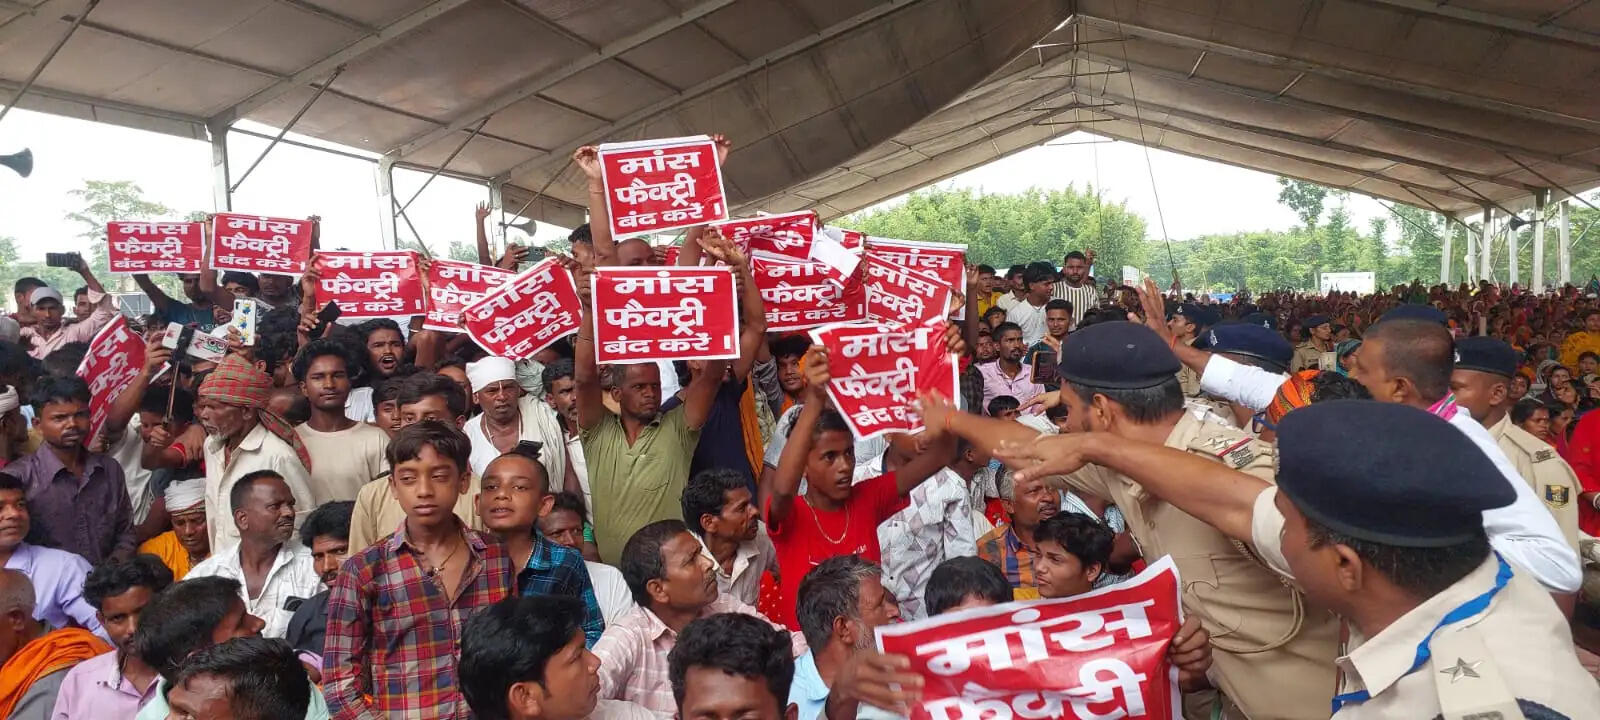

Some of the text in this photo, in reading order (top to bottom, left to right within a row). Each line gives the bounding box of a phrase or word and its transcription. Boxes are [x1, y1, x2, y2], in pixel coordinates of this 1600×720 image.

[617, 149, 702, 174] मांस
[615, 172, 697, 207] फैक्ट्री
[227, 217, 301, 235] मांस
[617, 210, 658, 228] बंद
[661, 202, 704, 221] करें
[113, 236, 183, 258] फैक्ट्री
[220, 231, 291, 259] फैक्ट्री
[113, 257, 147, 269] बंद
[218, 253, 252, 267] बंद
[326, 252, 410, 269] मांस
[321, 271, 401, 300] फैक्ट्री
[474, 267, 555, 320] मांस
[612, 271, 718, 294] मांस
[320, 299, 359, 312] ंद
[363, 298, 406, 312] करें
[481, 291, 562, 344] फैक्ट्री
[604, 297, 707, 336] फैक्ट्री
[602, 335, 653, 354] बंद
[657, 332, 712, 352] करें
[839, 326, 934, 358] मांस
[831, 356, 919, 402] फैक्ट्री
[851, 404, 892, 427] बंद
[915, 599, 1155, 676] मांस
